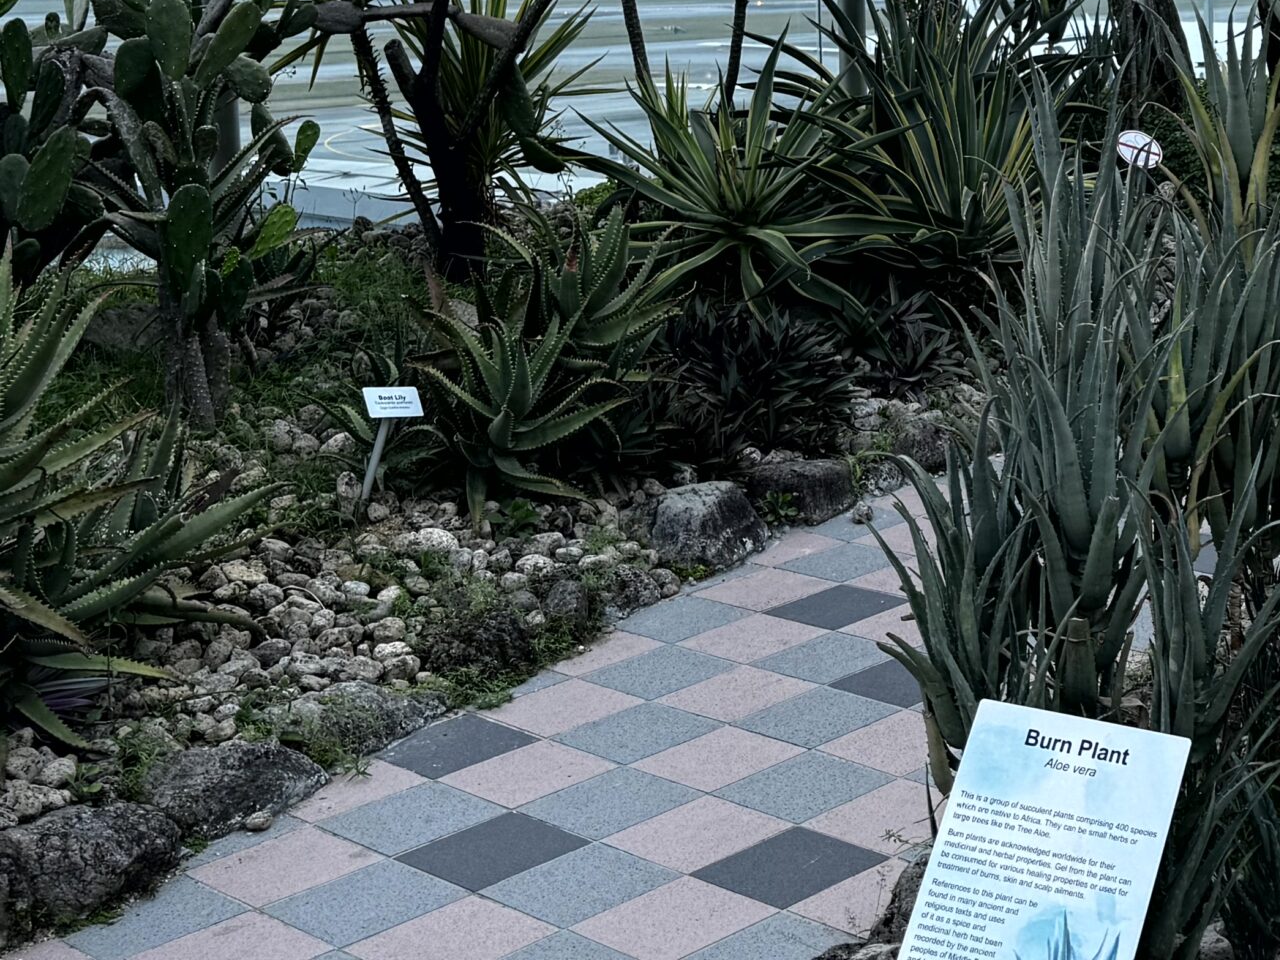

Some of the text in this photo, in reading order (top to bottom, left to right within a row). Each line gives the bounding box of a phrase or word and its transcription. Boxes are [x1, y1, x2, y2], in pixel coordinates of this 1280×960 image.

[1024, 729, 1129, 765] Burn Plant
[1044, 758, 1096, 777] Aloe vera
[953, 811, 970, 822] large
[972, 816, 989, 825] trees
[990, 819, 1002, 828] like
[1004, 822, 1015, 830] the
[1018, 824, 1032, 834] Tree
[957, 802, 976, 811] which
[990, 809, 1011, 818] native
[1045, 818, 1062, 830] They
[1078, 826, 1087, 834] be
[1088, 830, 1107, 838] small
[1109, 833, 1128, 844] herbs
[961, 790, 974, 799] This
[989, 798, 1010, 807] group
[1019, 804, 1052, 816] succulent
[1053, 810, 1074, 820] plants
[1076, 816, 1114, 830] comprising
[1115, 823, 1129, 832] 400
[1130, 827, 1157, 838] species
[944, 840, 977, 852] medicinal
[992, 850, 1015, 860] herbal
[1055, 862, 1068, 871] Gel
[1068, 866, 1085, 876] from
[1086, 869, 1098, 878] the
[1099, 873, 1117, 883] plant
[948, 828, 964, 838] Burn
[965, 833, 986, 843] plants
[1052, 852, 1087, 864] worldwide
[1088, 858, 1098, 866] for
[1100, 861, 1116, 870] their
[937, 861, 970, 874] treatment
[1003, 875, 1017, 884] skin
[1018, 880, 1033, 888] and
[1034, 883, 1052, 893] scalp
[940, 850, 950, 858] be
[951, 853, 987, 866] consumed
[988, 860, 998, 868] for
[1000, 864, 1024, 874] various
[1026, 868, 1052, 882] healing
[1052, 875, 1088, 888] properties
[1099, 886, 1117, 894] used
[1118, 888, 1128, 896] for
[928, 889, 948, 900] found
[957, 897, 977, 907] many
[978, 901, 1004, 912] ancient
[1005, 907, 1019, 915] and
[932, 878, 971, 893] References
[981, 889, 993, 898] this
[994, 893, 1013, 902] plant
[1029, 899, 1038, 908] be
[924, 901, 1005, 924] religious texts and uses
[952, 919, 971, 928] spice
[972, 924, 986, 932] and
[914, 934, 996, 958] recorded by the ancient
[918, 923, 1002, 947] medicinal herb had been
[910, 945, 938, 957] peoples
